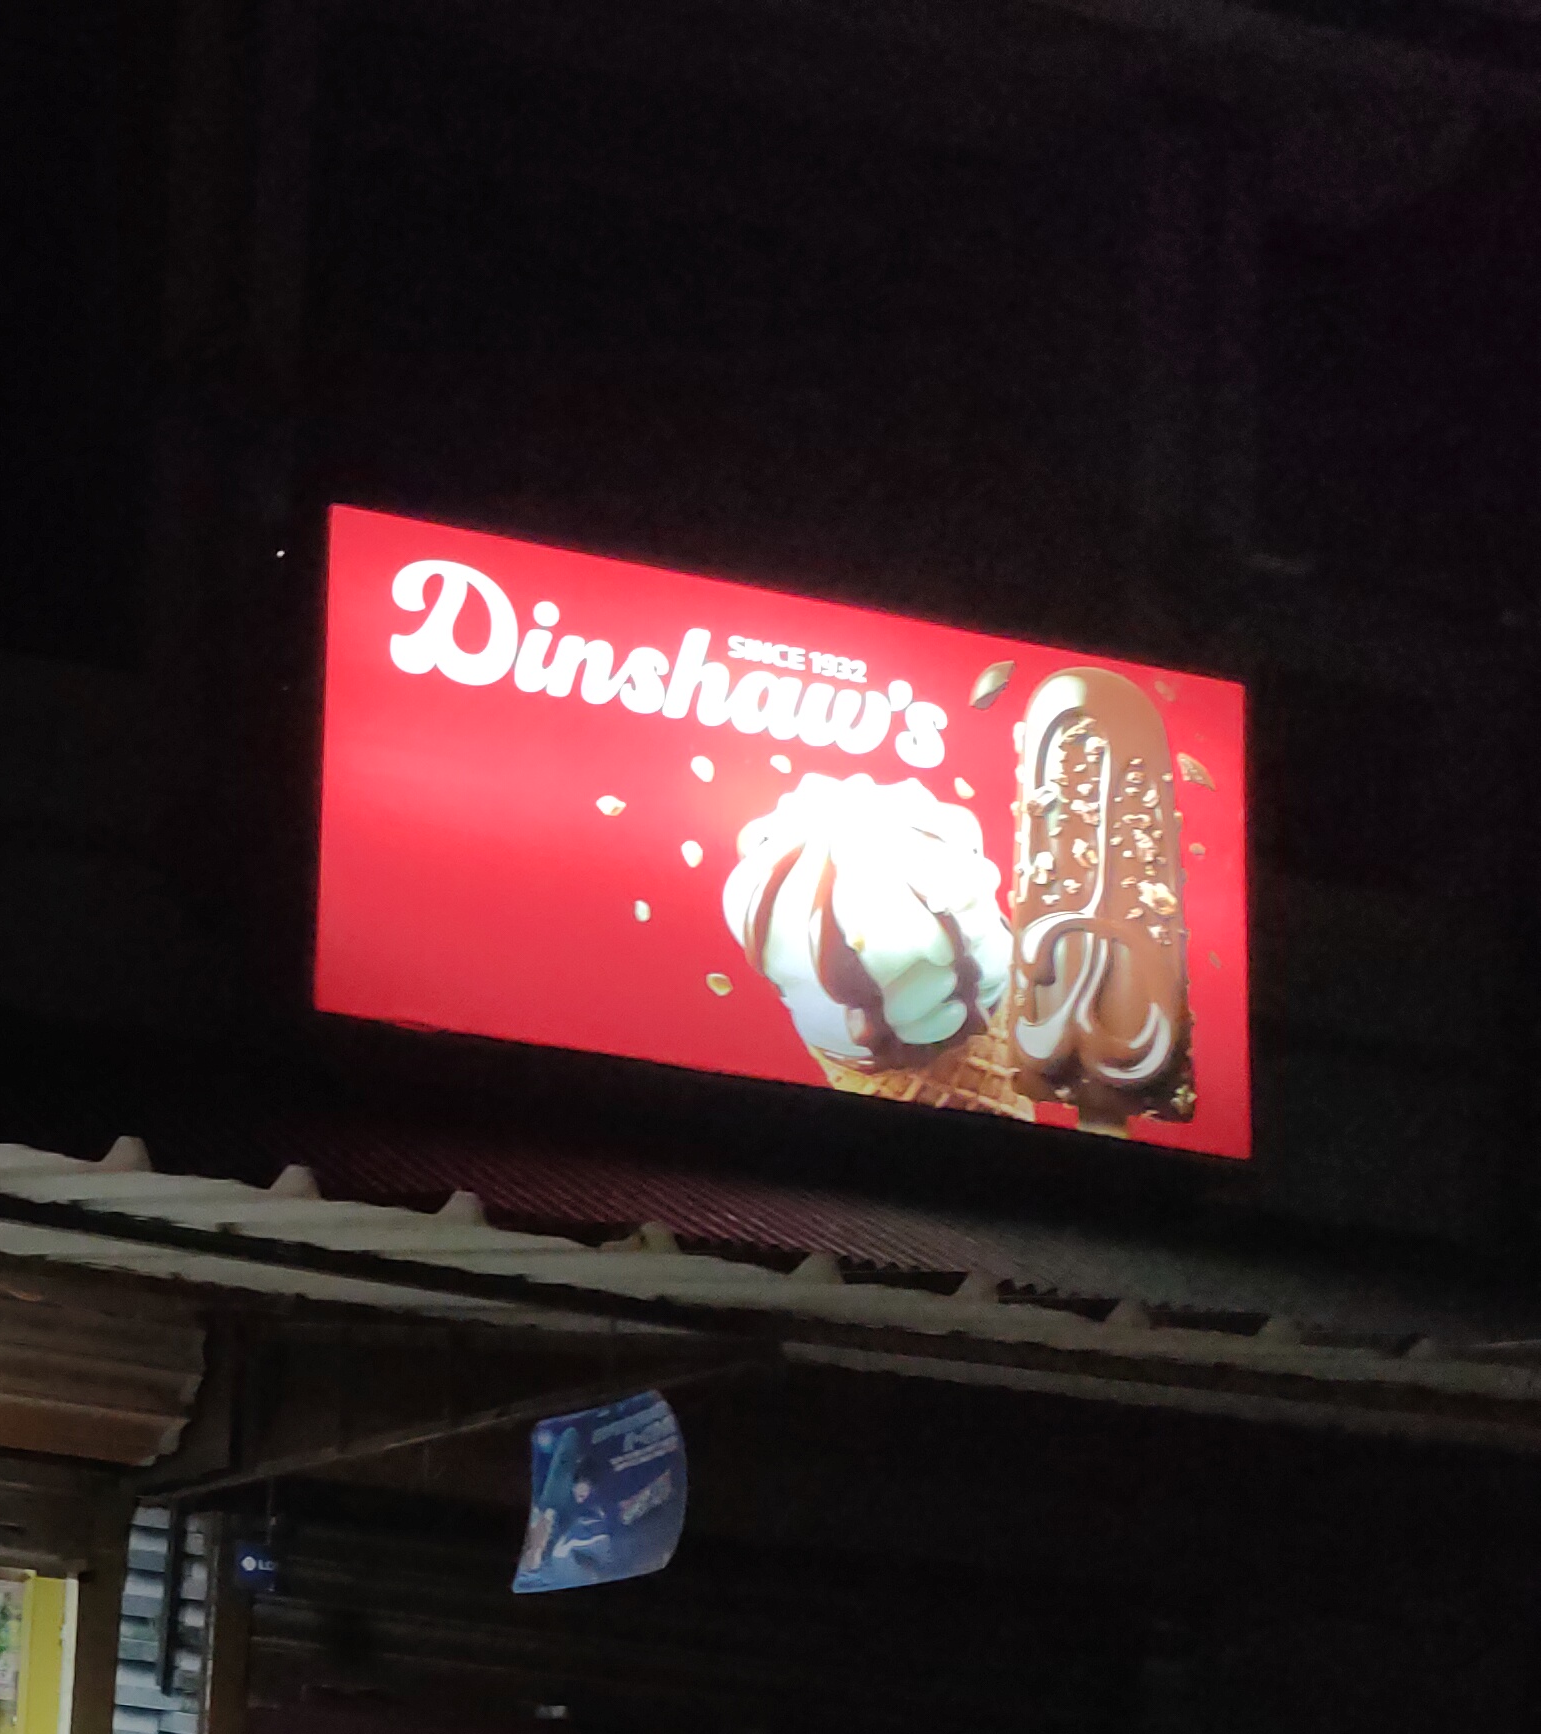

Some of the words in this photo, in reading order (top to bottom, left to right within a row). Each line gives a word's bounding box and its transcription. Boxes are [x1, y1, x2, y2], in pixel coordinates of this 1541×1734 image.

[390, 559, 949, 768] Dinshaw's
[727, 634, 806, 671] SINCE
[808, 651, 868, 683] 1932
